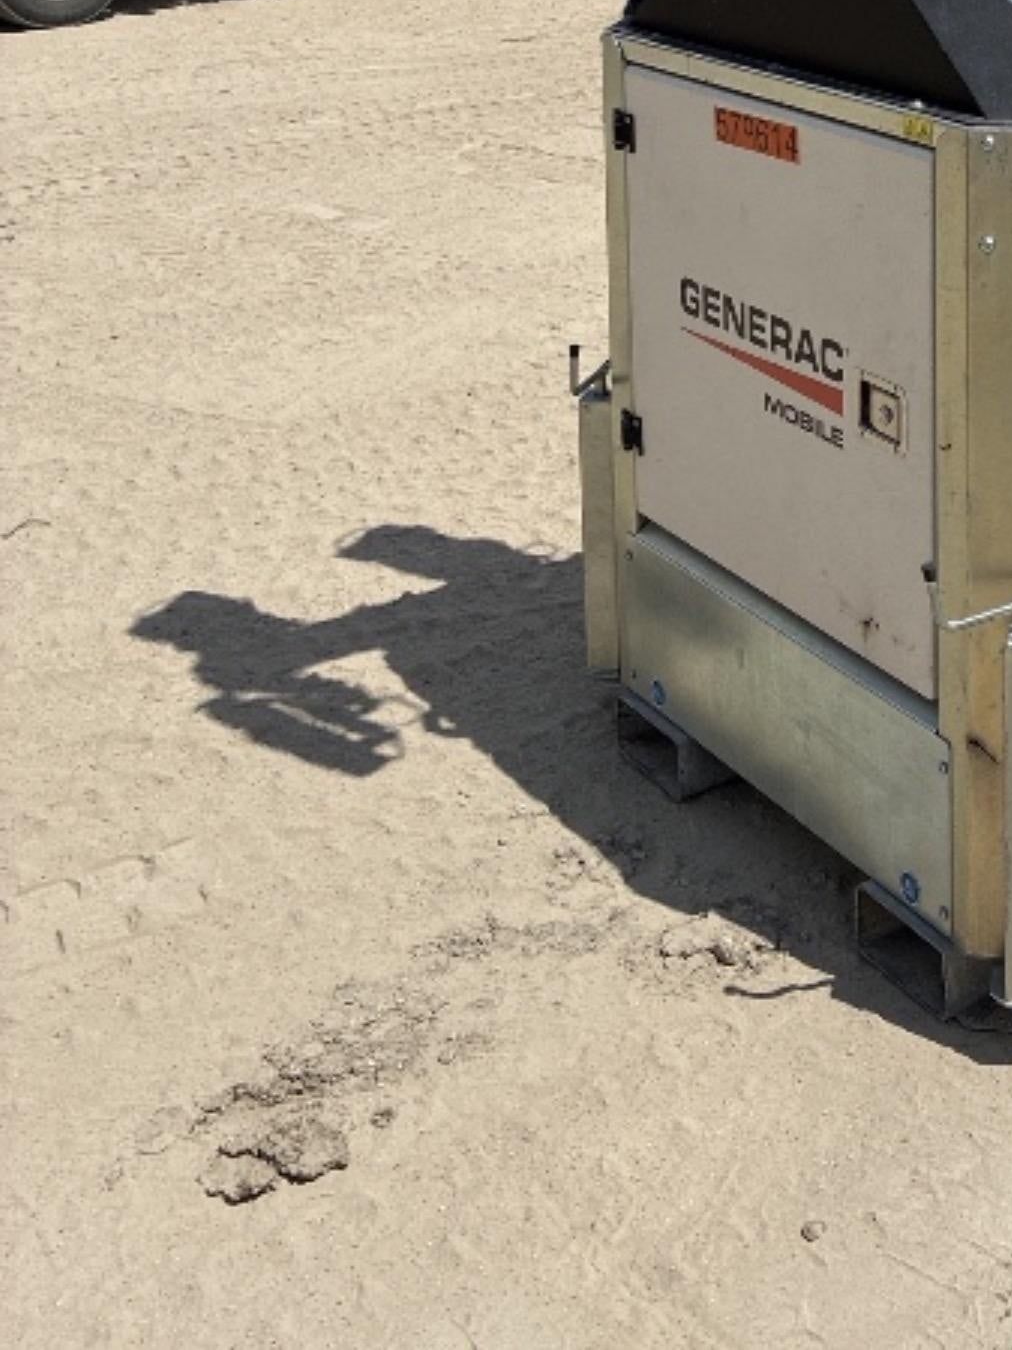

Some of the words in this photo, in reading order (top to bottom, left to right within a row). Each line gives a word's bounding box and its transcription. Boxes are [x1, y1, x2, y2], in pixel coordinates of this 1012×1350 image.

[715, 108, 799, 162] 579614
[680, 276, 844, 382] GENERAC
[764, 392, 844, 450] MOBILE
